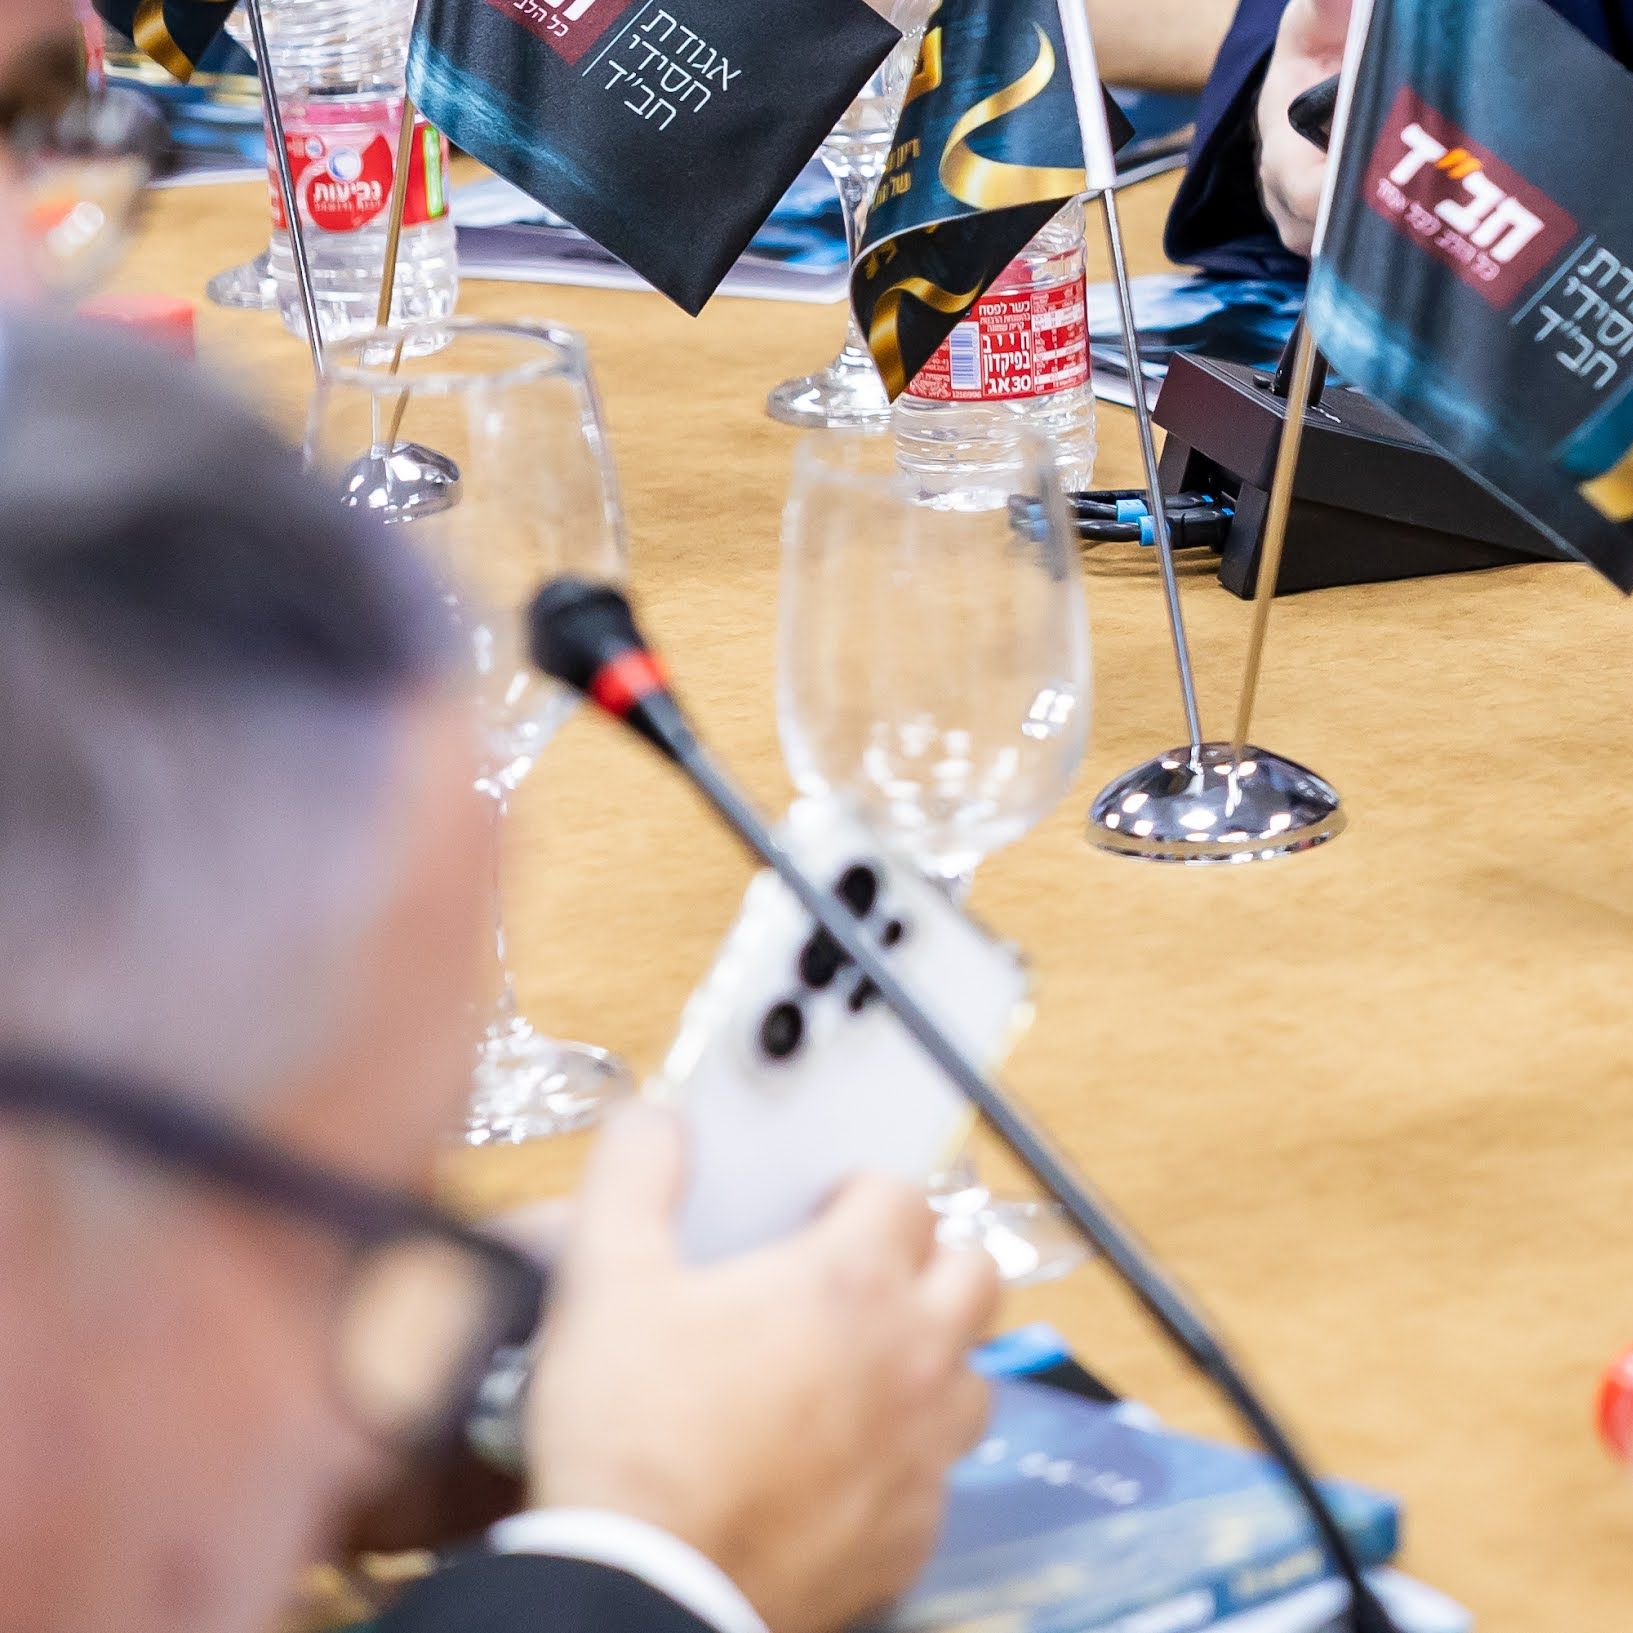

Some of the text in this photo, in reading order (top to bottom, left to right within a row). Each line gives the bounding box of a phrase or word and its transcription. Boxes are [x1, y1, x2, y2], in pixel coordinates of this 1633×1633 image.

[546, 13, 569, 37] כל
[641, 8, 742, 92] אגודת
[604, 59, 677, 132] חב"ד
[628, 33, 712, 113] חסידי
[313, 179, 382, 209] נביעות
[1388, 122, 1546, 264] חב"ד
[978, 300, 1030, 317] כשר לפסח
[982, 351, 1031, 384] בפיקדון
